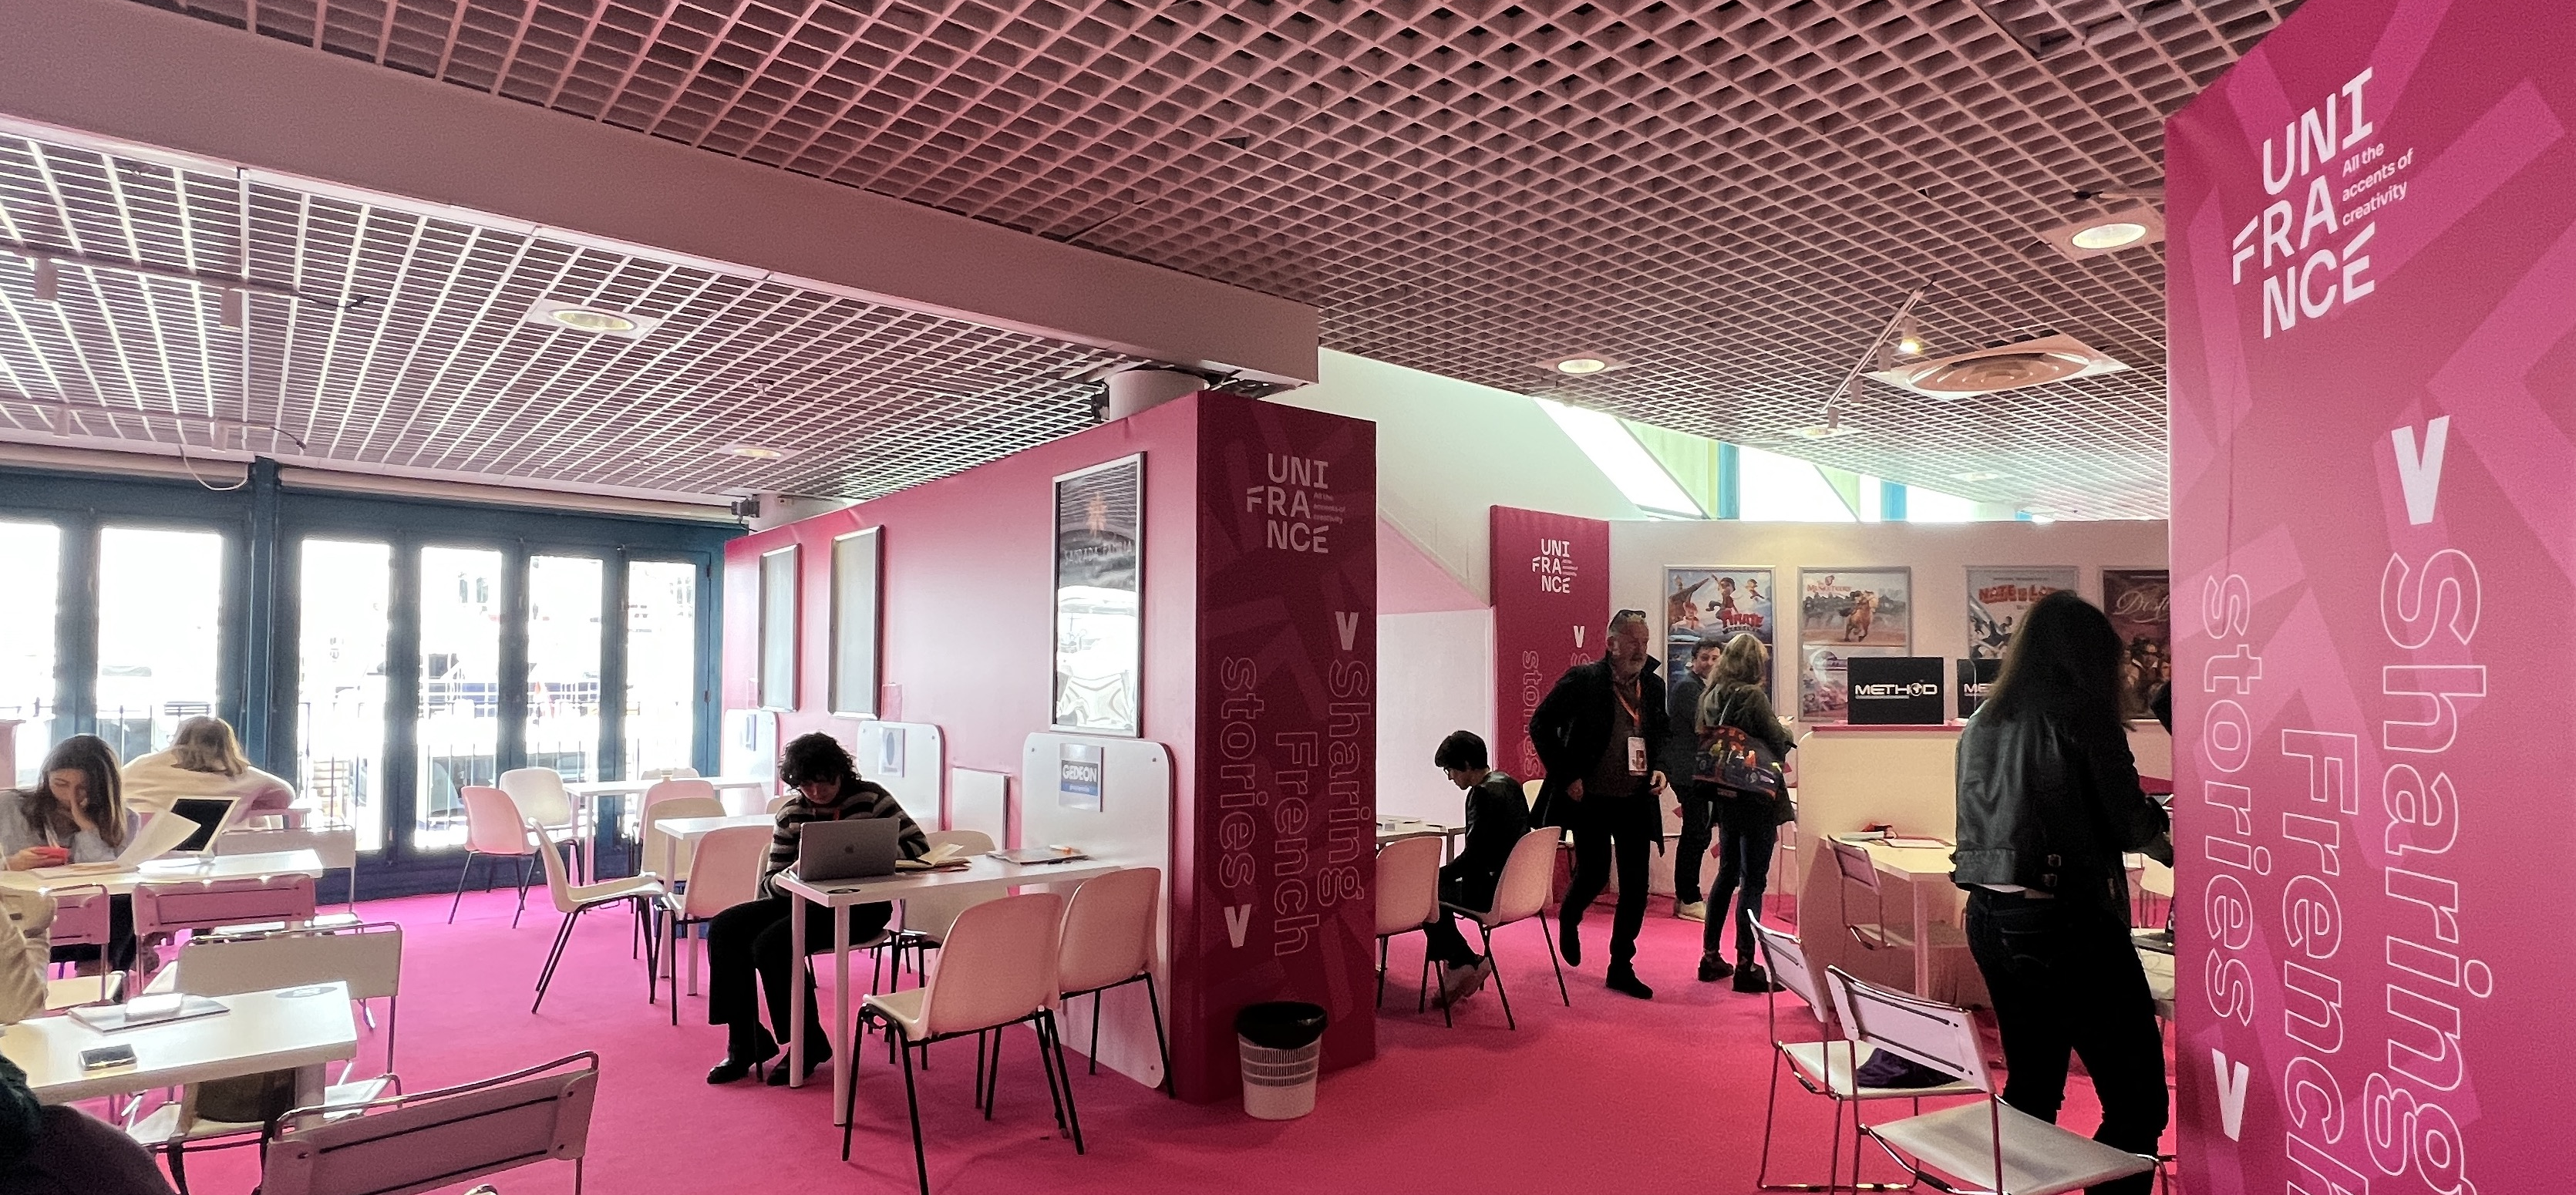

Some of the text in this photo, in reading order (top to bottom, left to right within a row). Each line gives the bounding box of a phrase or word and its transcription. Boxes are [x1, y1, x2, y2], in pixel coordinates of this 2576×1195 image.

[2263, 66, 2373, 196] UNI
[2342, 143, 2385, 178] All the
[2342, 147, 2414, 202] accents of
[2342, 181, 2407, 226] creativity
[2232, 174, 2339, 285] FRA
[1247, 485, 1312, 519] FRA
[1268, 453, 1329, 490] UNI
[1532, 556, 1562, 575] FRA
[1541, 537, 1571, 558] UNI
[1219, 656, 1269, 888] stories
[1317, 659, 1372, 907] Sharing
[2202, 574, 2271, 1027] stories
[1274, 731, 1319, 957] French
[2362, 548, 2494, 1195] Sharing
